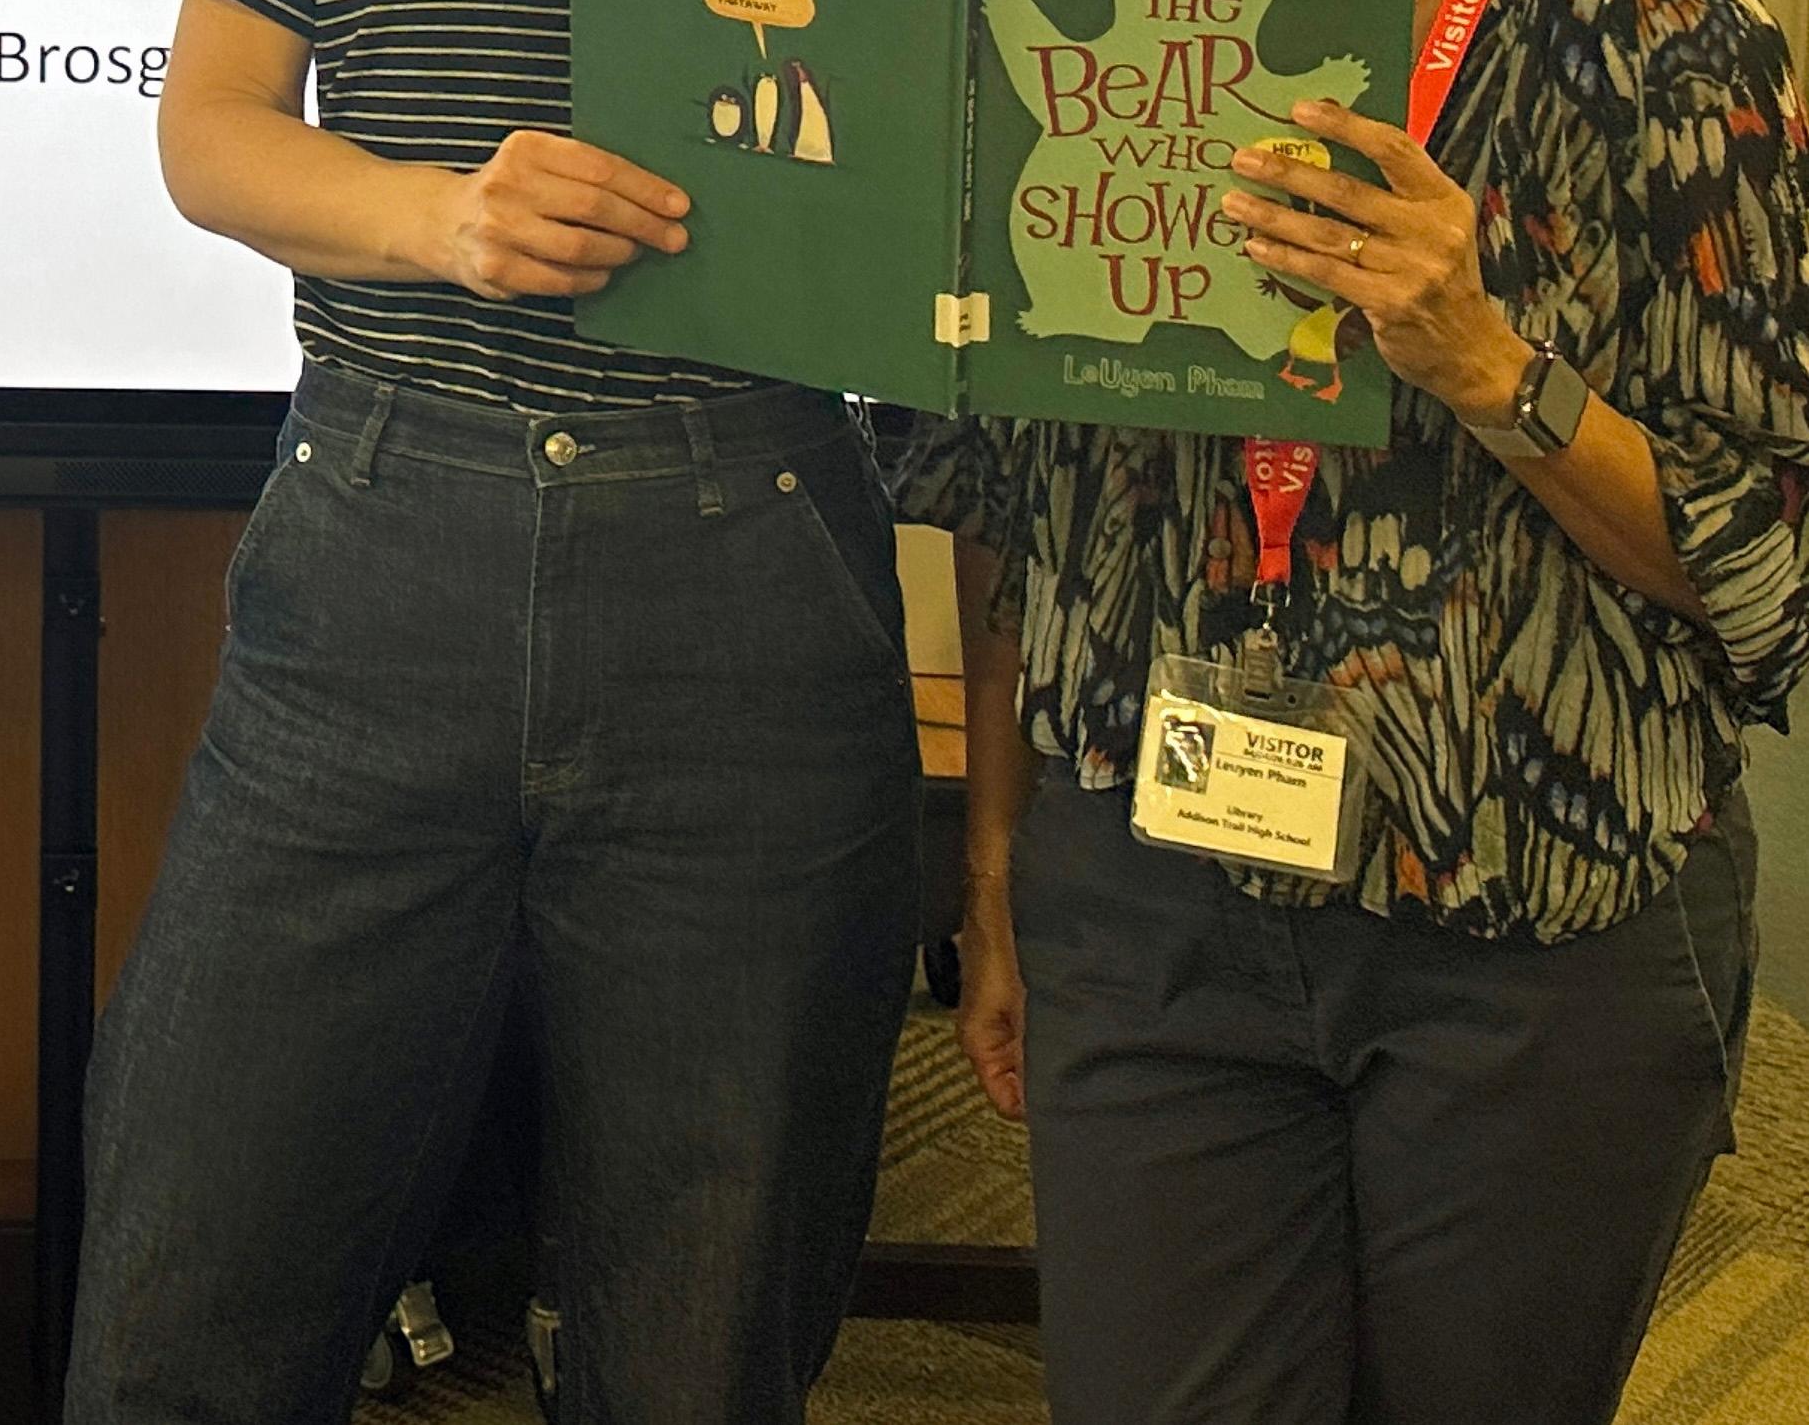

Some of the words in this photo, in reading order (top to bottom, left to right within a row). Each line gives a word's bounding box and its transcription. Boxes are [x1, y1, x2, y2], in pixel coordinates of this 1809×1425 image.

[1091, 125, 1240, 172] WHO
[1245, 731, 1324, 762] VISITOR
[1275, 830, 1311, 847] School
